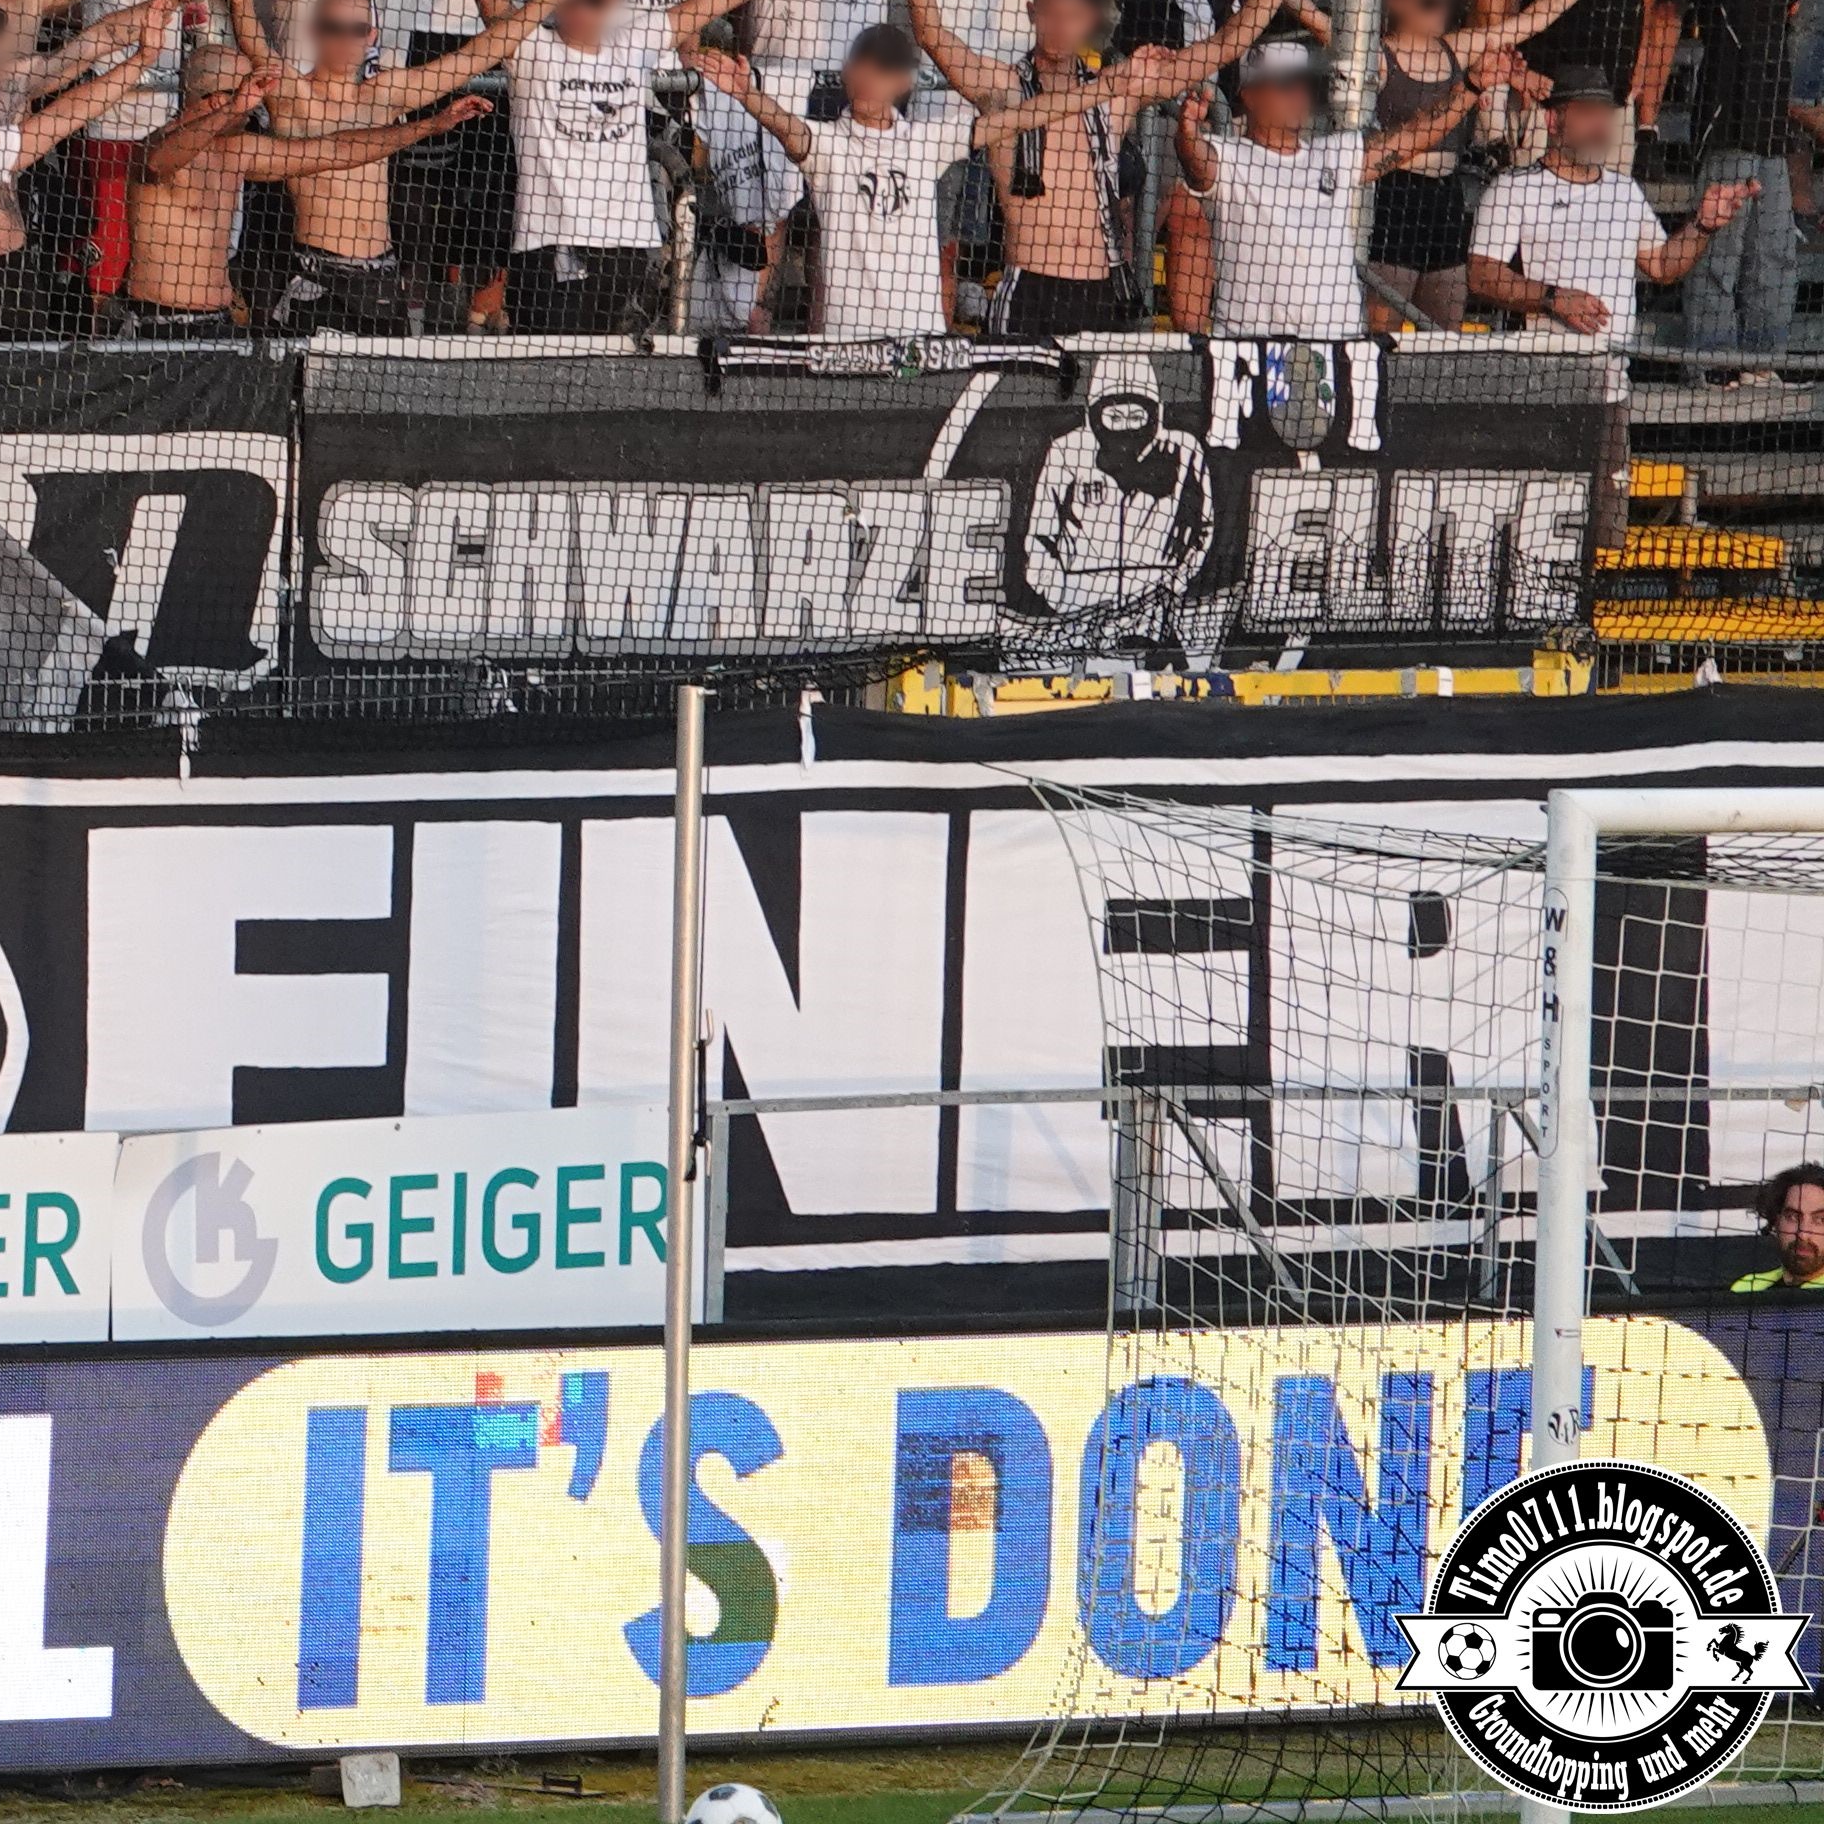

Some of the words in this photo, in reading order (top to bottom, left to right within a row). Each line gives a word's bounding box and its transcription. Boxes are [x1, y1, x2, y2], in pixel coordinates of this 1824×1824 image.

[314, 372, 1014, 659] SCHWARZE
[1244, 467, 1593, 634] ELITE
[85, 799, 1608, 1216] EINER
[313, 1161, 668, 1285] GEIGER
[296, 1371, 786, 1710] IT'S
